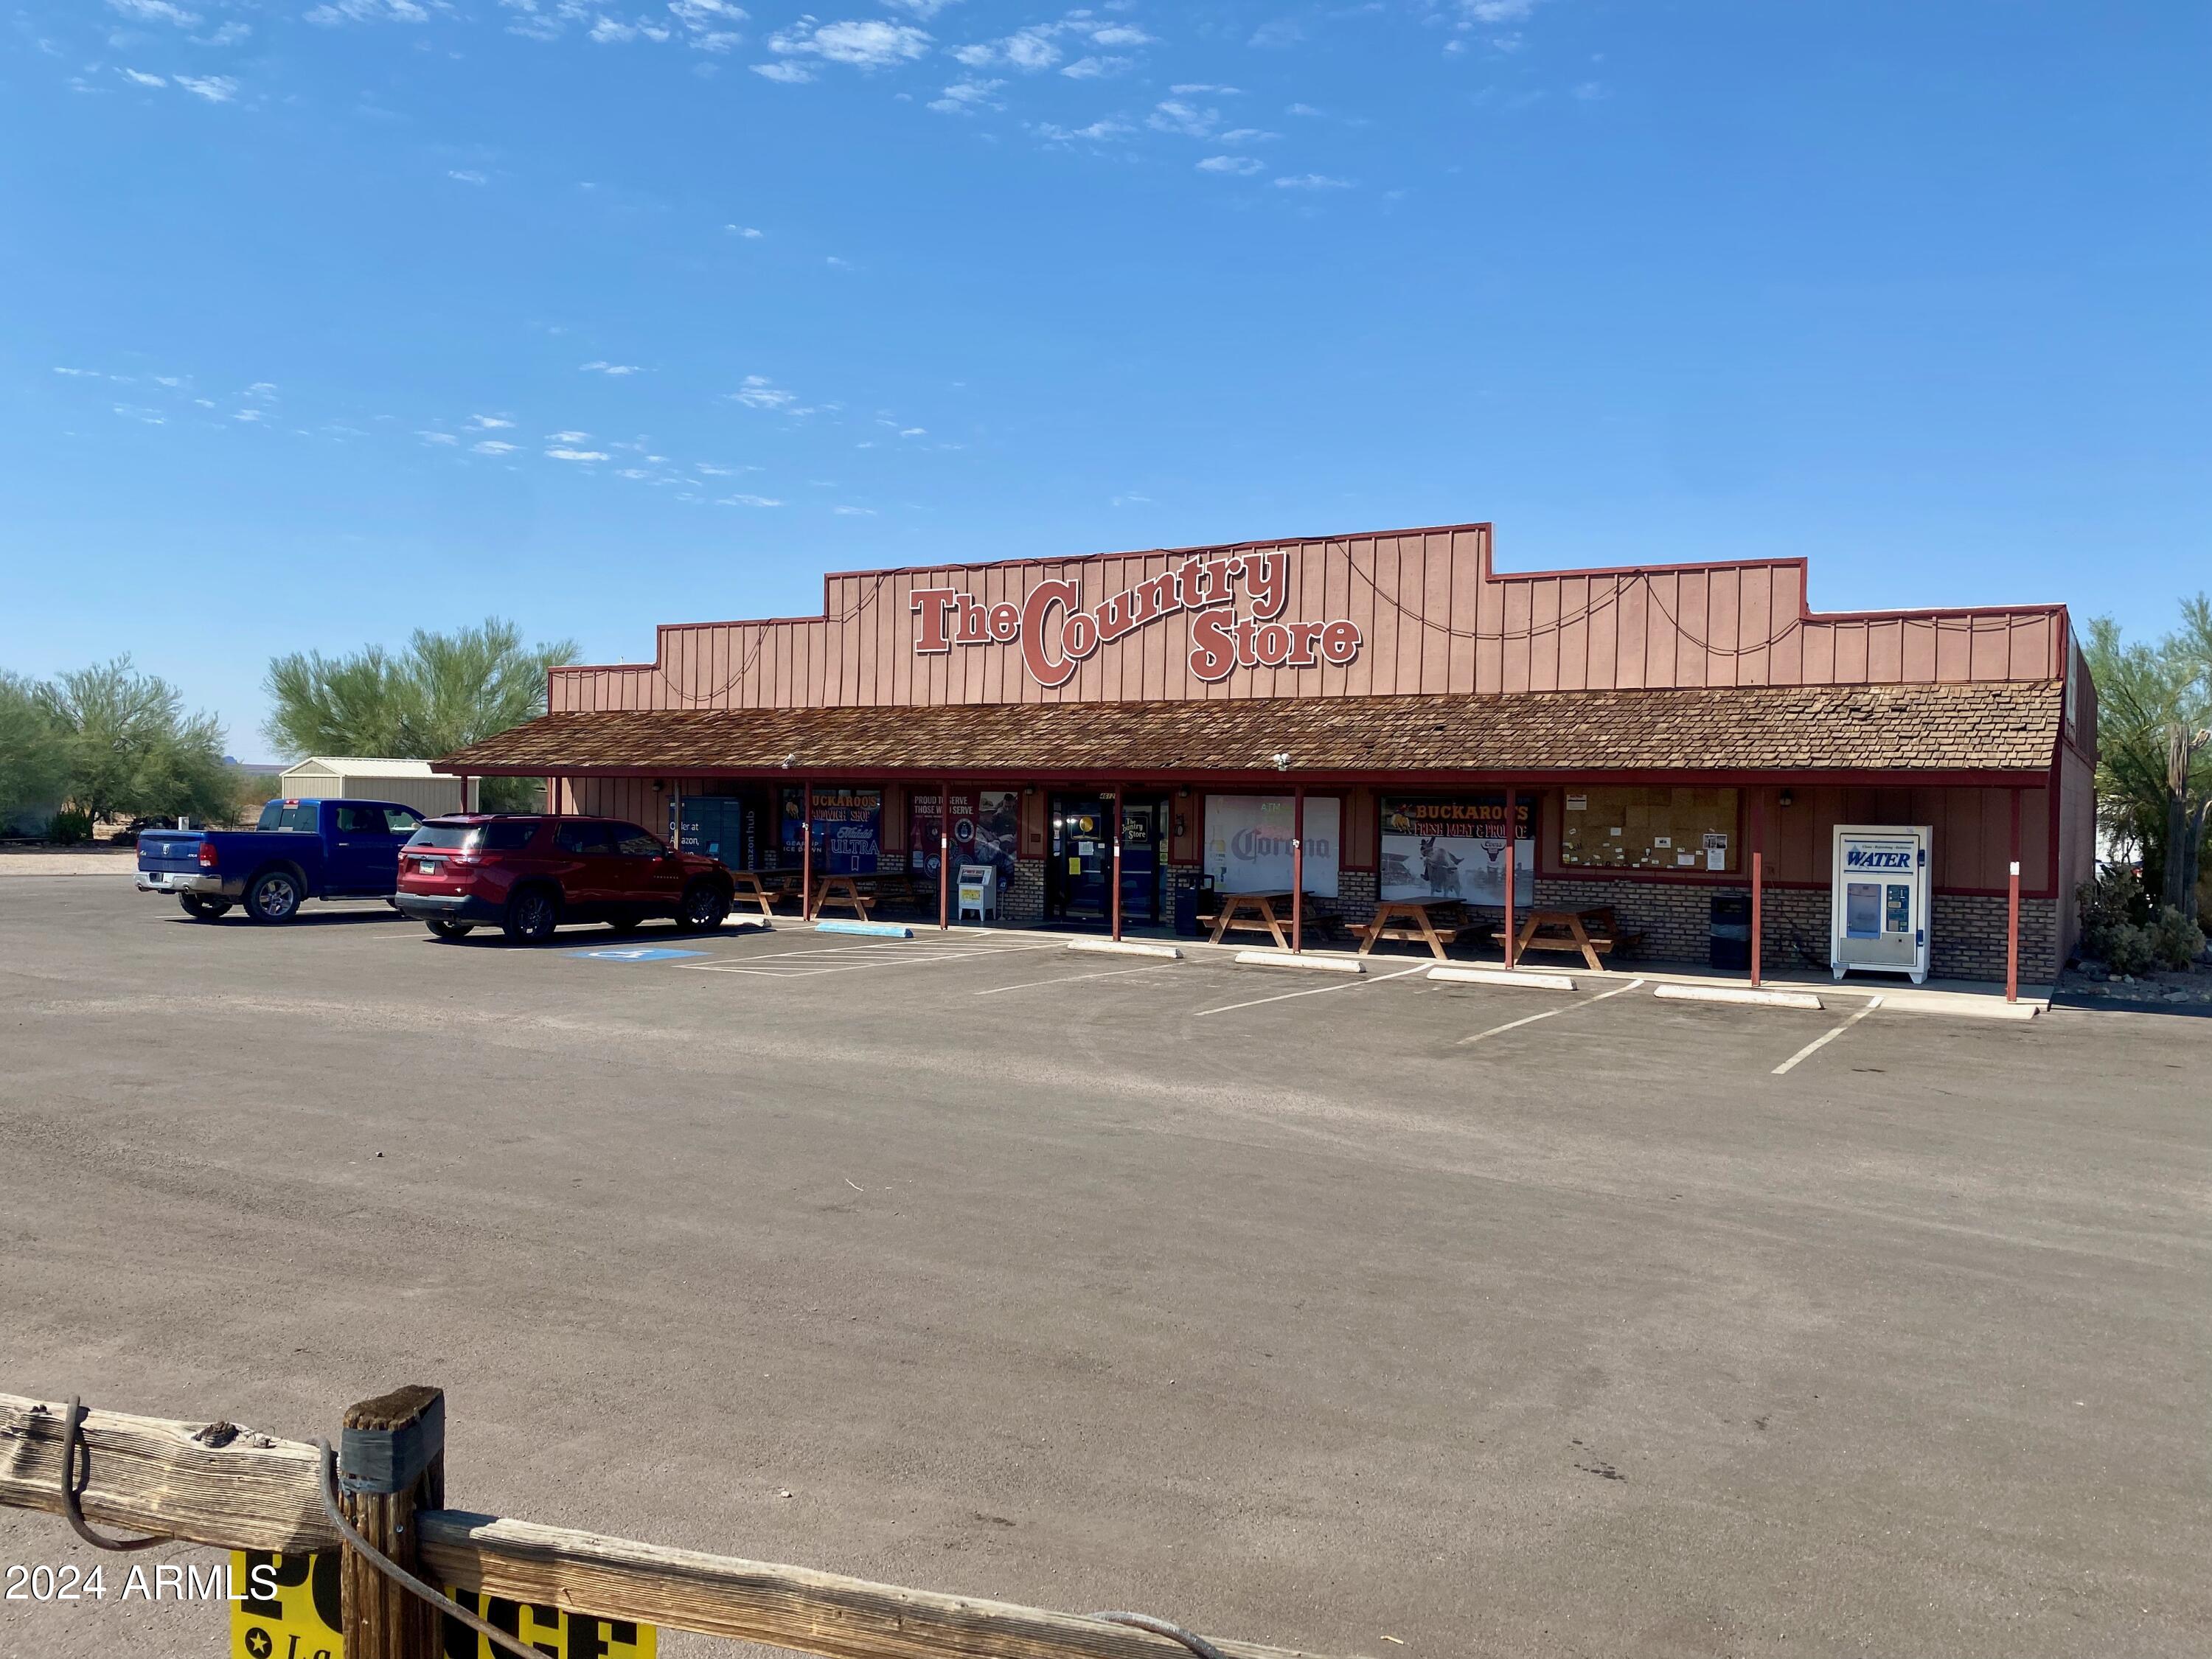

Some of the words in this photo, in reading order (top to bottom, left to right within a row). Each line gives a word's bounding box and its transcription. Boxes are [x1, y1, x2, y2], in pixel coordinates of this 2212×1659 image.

[910, 588, 1020, 653] The
[1021, 551, 1287, 686] Country
[1188, 608, 1362, 681] Store
[813, 796, 877, 807] UCKAROO'S
[914, 796, 936, 804] PROUD
[812, 809, 846, 821] ANDWICH
[914, 805, 935, 814] THOSE
[1416, 805, 1528, 820] BUCKARO'S
[669, 821, 690, 831] Oer
[691, 823, 699, 831] at
[745, 810, 755, 834] hub
[1128, 830, 1146, 840] Store
[1414, 822, 1443, 836] FRESH
[1447, 823, 1475, 837] MEAT
[1476, 824, 1484, 838] &
[1486, 824, 1528, 839] PROCE
[669, 835, 700, 846] Aazon,
[831, 839, 880, 855] ULTRA
[1848, 851, 1910, 868] WATER
